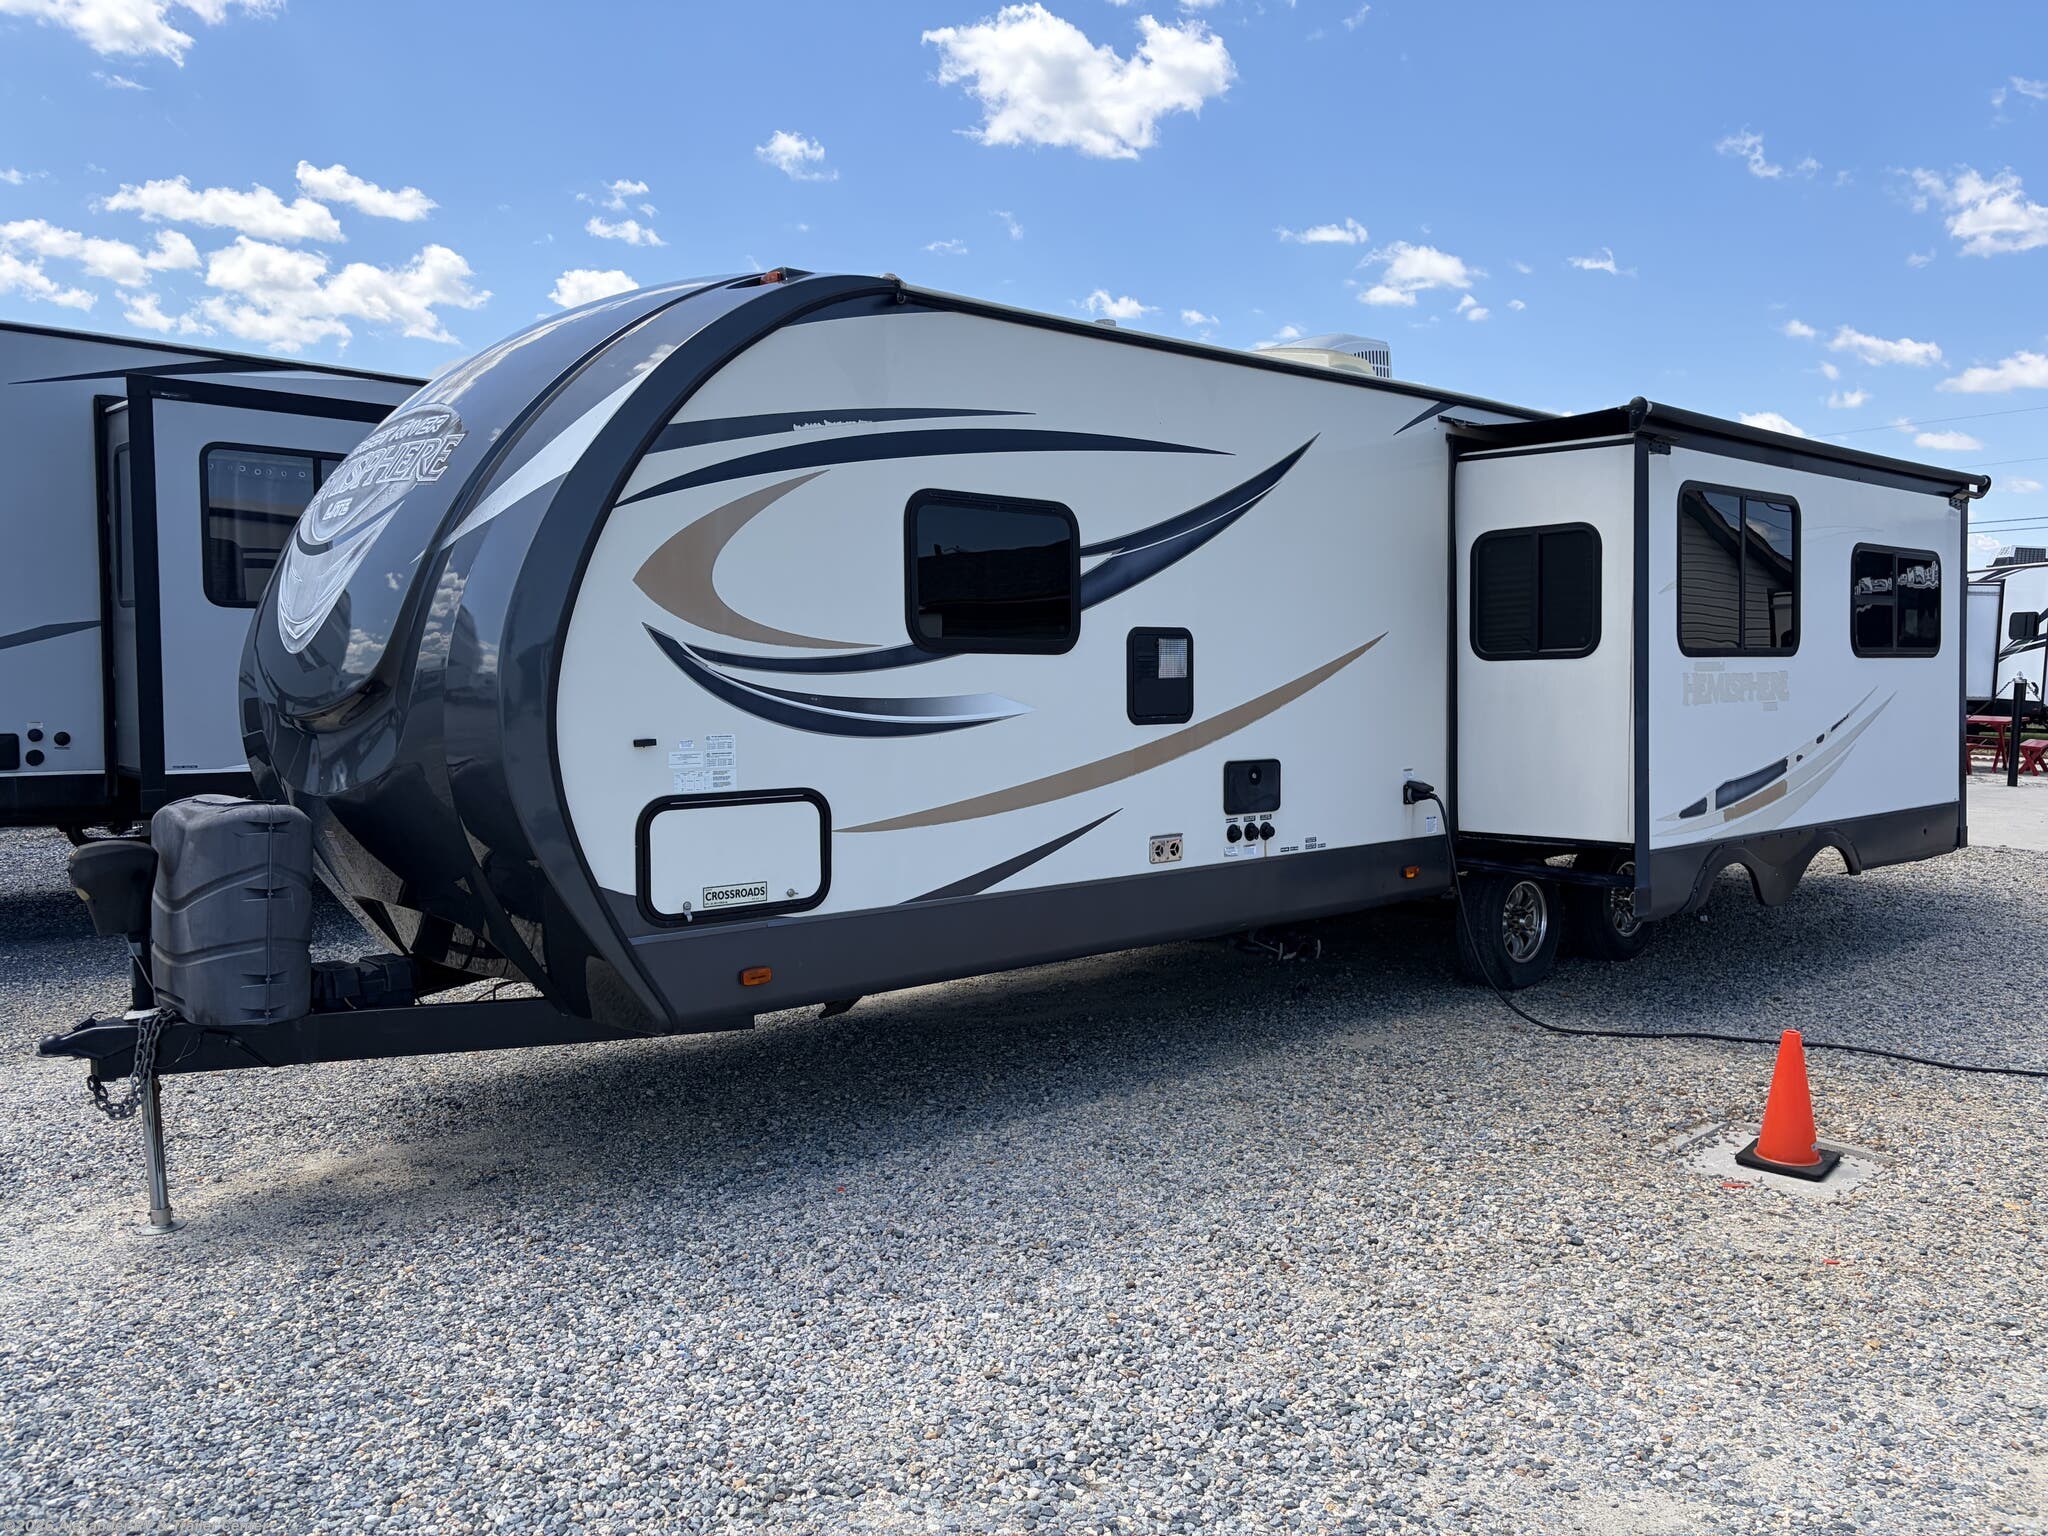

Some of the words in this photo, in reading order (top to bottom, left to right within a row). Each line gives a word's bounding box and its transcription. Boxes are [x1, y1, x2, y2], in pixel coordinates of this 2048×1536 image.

[390, 414, 450, 442] RIVER
[322, 498, 352, 520] LITE
[705, 886, 765, 901] CROSSROADS
